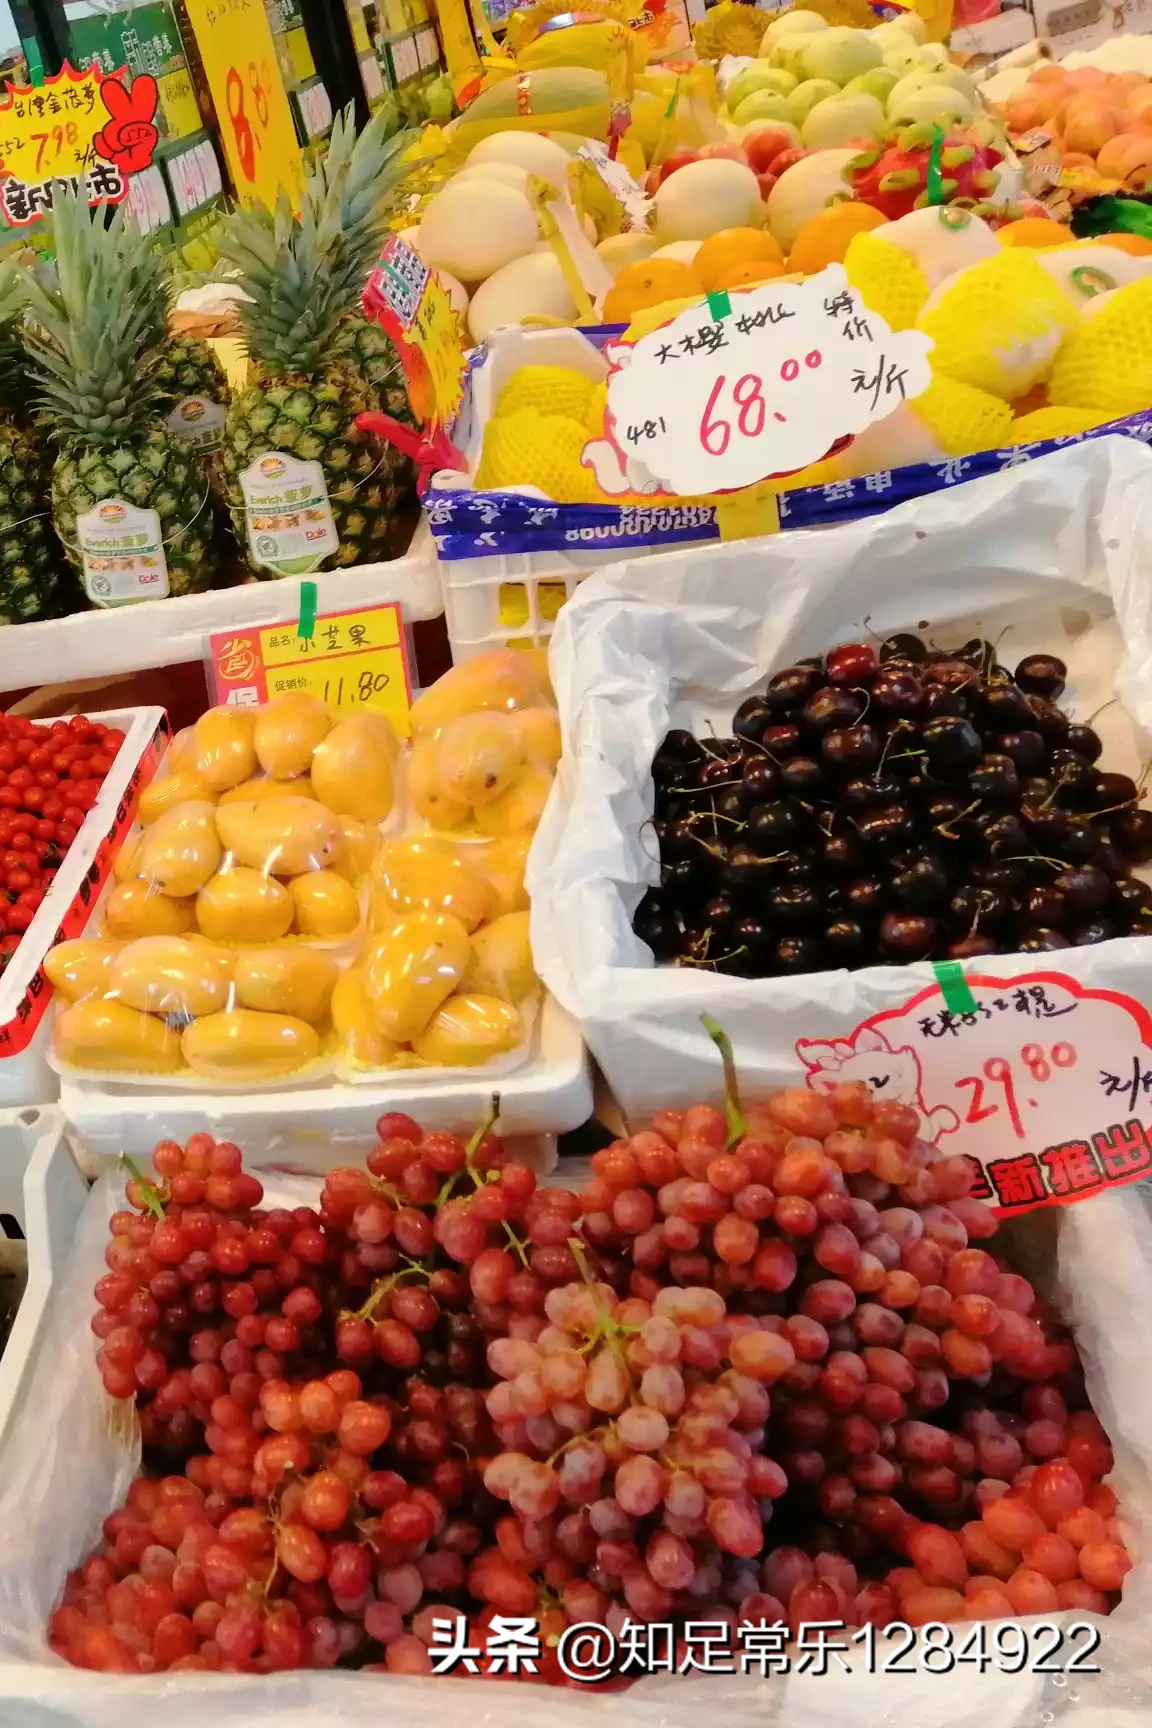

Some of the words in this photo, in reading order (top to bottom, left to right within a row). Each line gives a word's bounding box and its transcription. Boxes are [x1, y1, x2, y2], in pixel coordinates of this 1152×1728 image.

[30, 121, 79, 175] 7.98
[125, 127, 153, 143] 552
[4, 163, 122, 221] 新市
[823, 289, 874, 343] 特价
[700, 349, 823, 457] 68.00
[850, 354, 909, 412] 元/斤
[626, 416, 667, 446] 481
[323, 671, 391, 706] 11.80
[954, 1041, 1079, 1140] 29.80
